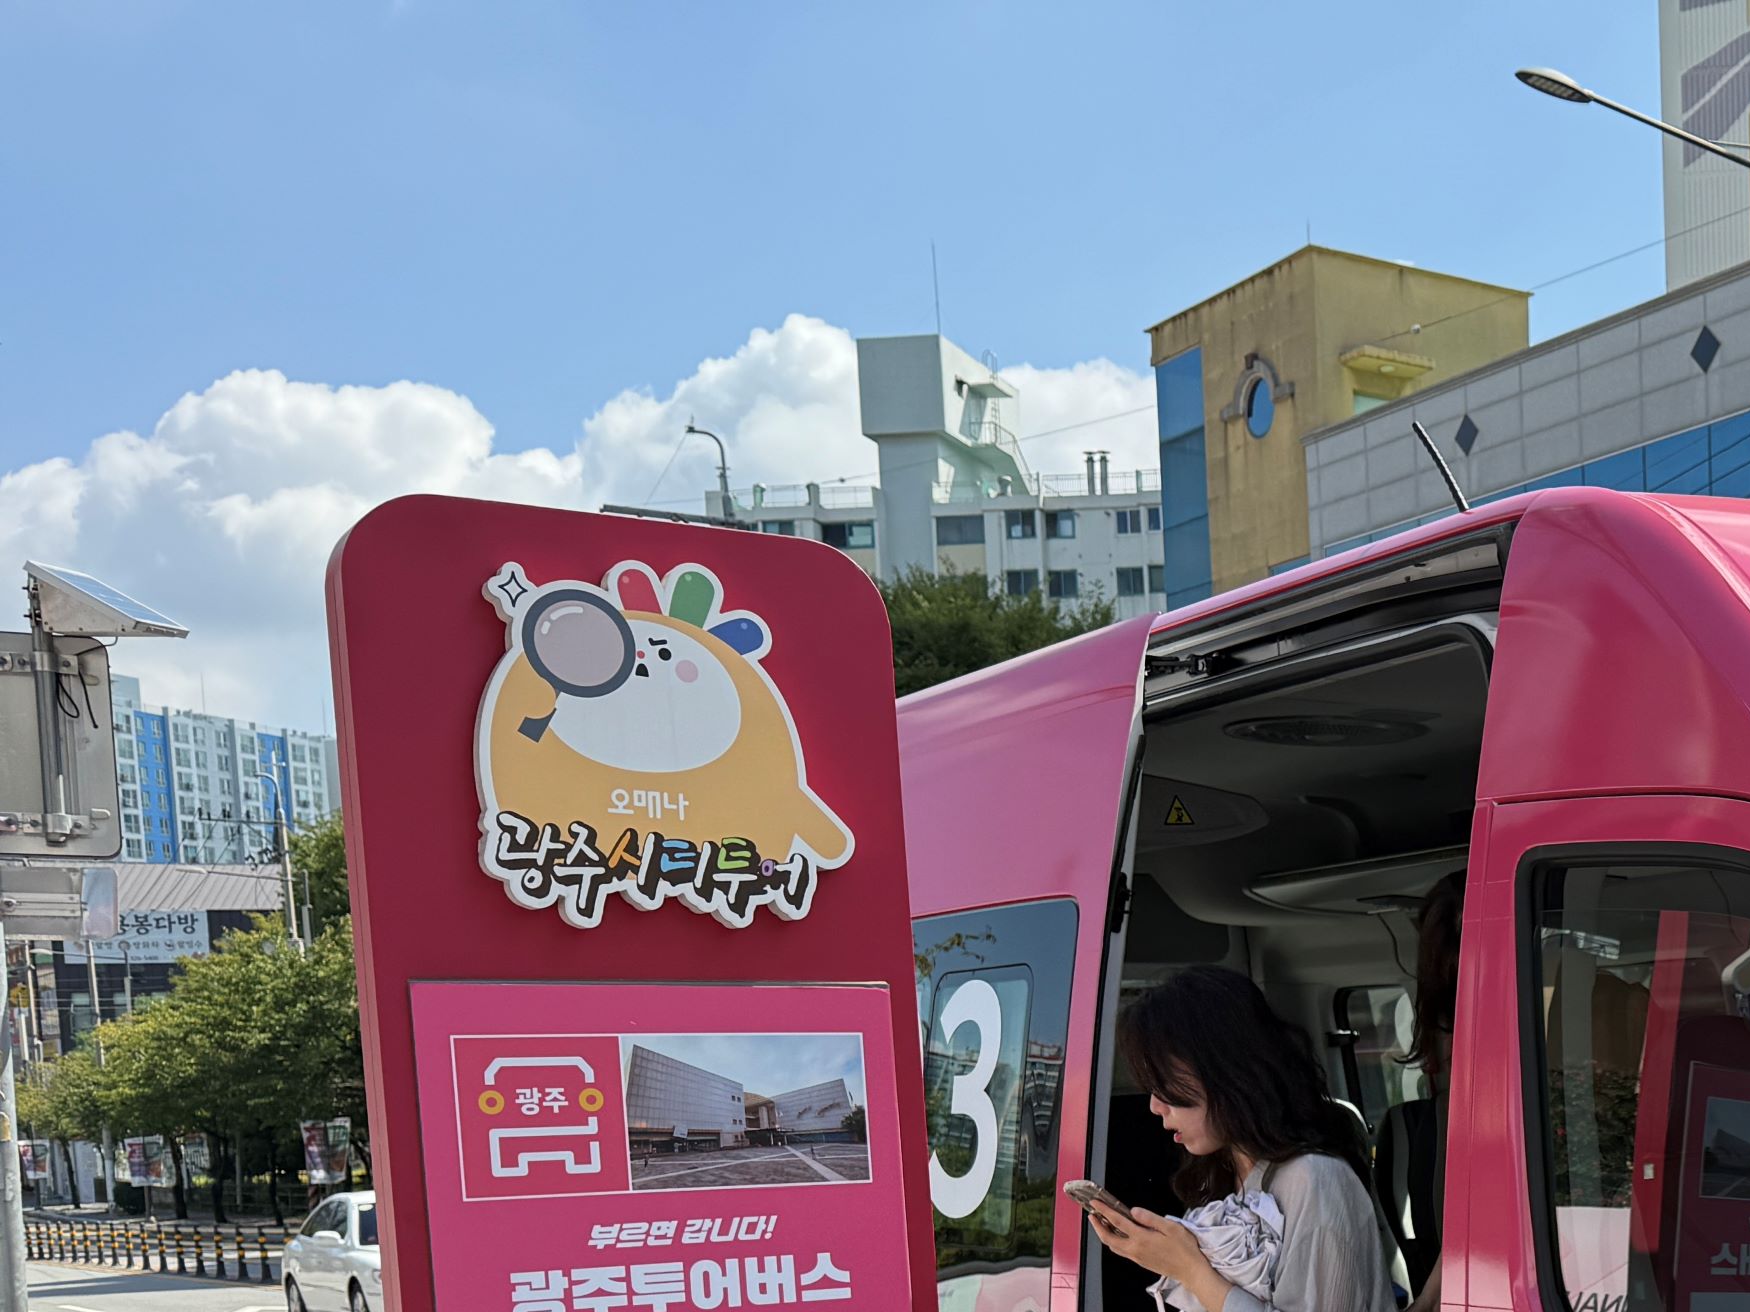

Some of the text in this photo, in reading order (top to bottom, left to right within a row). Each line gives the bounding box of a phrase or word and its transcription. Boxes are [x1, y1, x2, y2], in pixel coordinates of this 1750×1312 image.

[607, 788, 689, 821] 오매나
[497, 812, 809, 918] 광주시티투어
[514, 1086, 569, 1116] 광주
[919, 979, 1001, 1218] 3
[587, 1215, 778, 1250] 부르면 갑니다!
